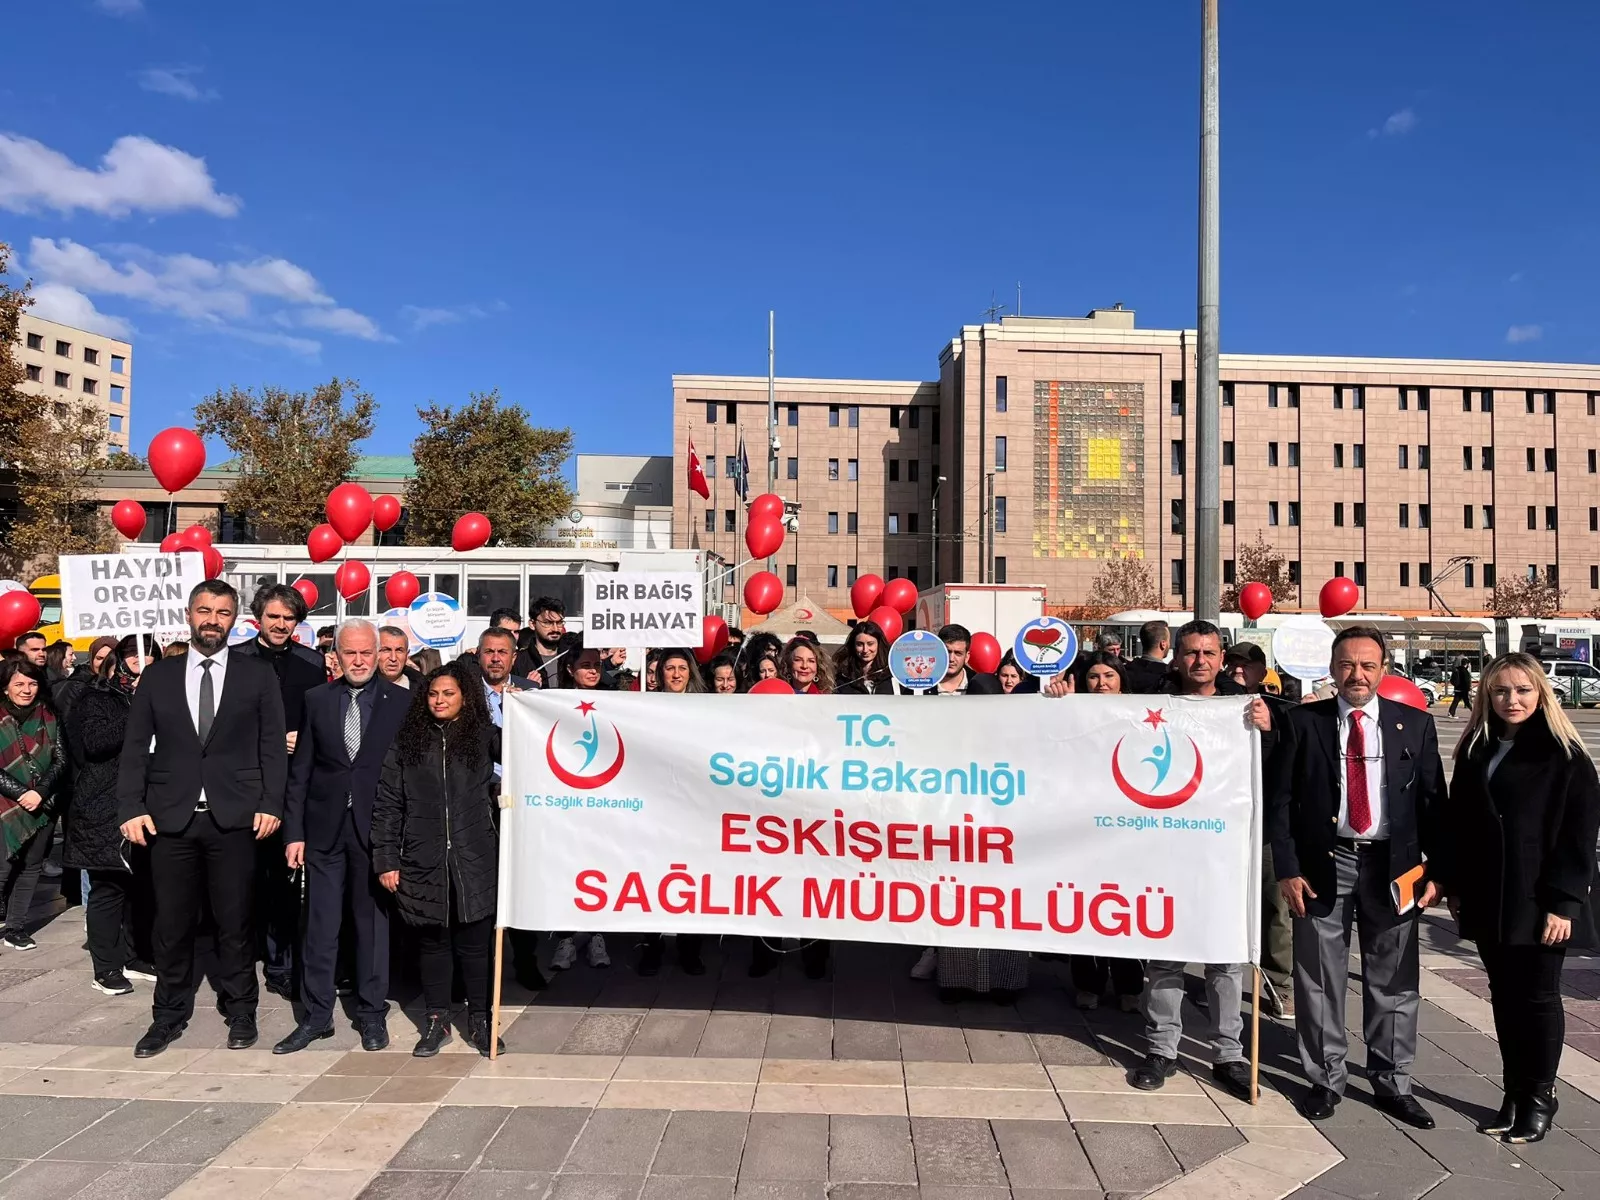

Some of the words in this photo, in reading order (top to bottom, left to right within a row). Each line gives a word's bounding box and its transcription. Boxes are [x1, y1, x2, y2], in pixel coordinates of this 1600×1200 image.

[91, 552, 183, 580] HAYDİ
[94, 583, 183, 604] ORGAN
[596, 580, 628, 600] BİR
[634, 580, 693, 602] BAĞIŞ
[79, 606, 186, 631] BAĞIŞIN
[591, 608, 626, 629] BİR
[630, 612, 697, 629] HAYAT
[837, 714, 896, 747] T.C.
[709, 752, 829, 799] Sağlık
[842, 759, 1026, 807] Bakanlığı
[525, 795, 543, 806] T.C.
[545, 795, 583, 810] Sağlık
[586, 796, 643, 812] Bakanlığı
[721, 808, 1014, 864] ESKİŞEHİR
[1094, 816, 1114, 827] T.C.
[1117, 816, 1159, 830] Sağlık
[1163, 816, 1226, 833] Bakanlığı
[573, 864, 783, 917] SAĞLIK
[802, 872, 1175, 939] MÜDÜRLÜĞÜ
